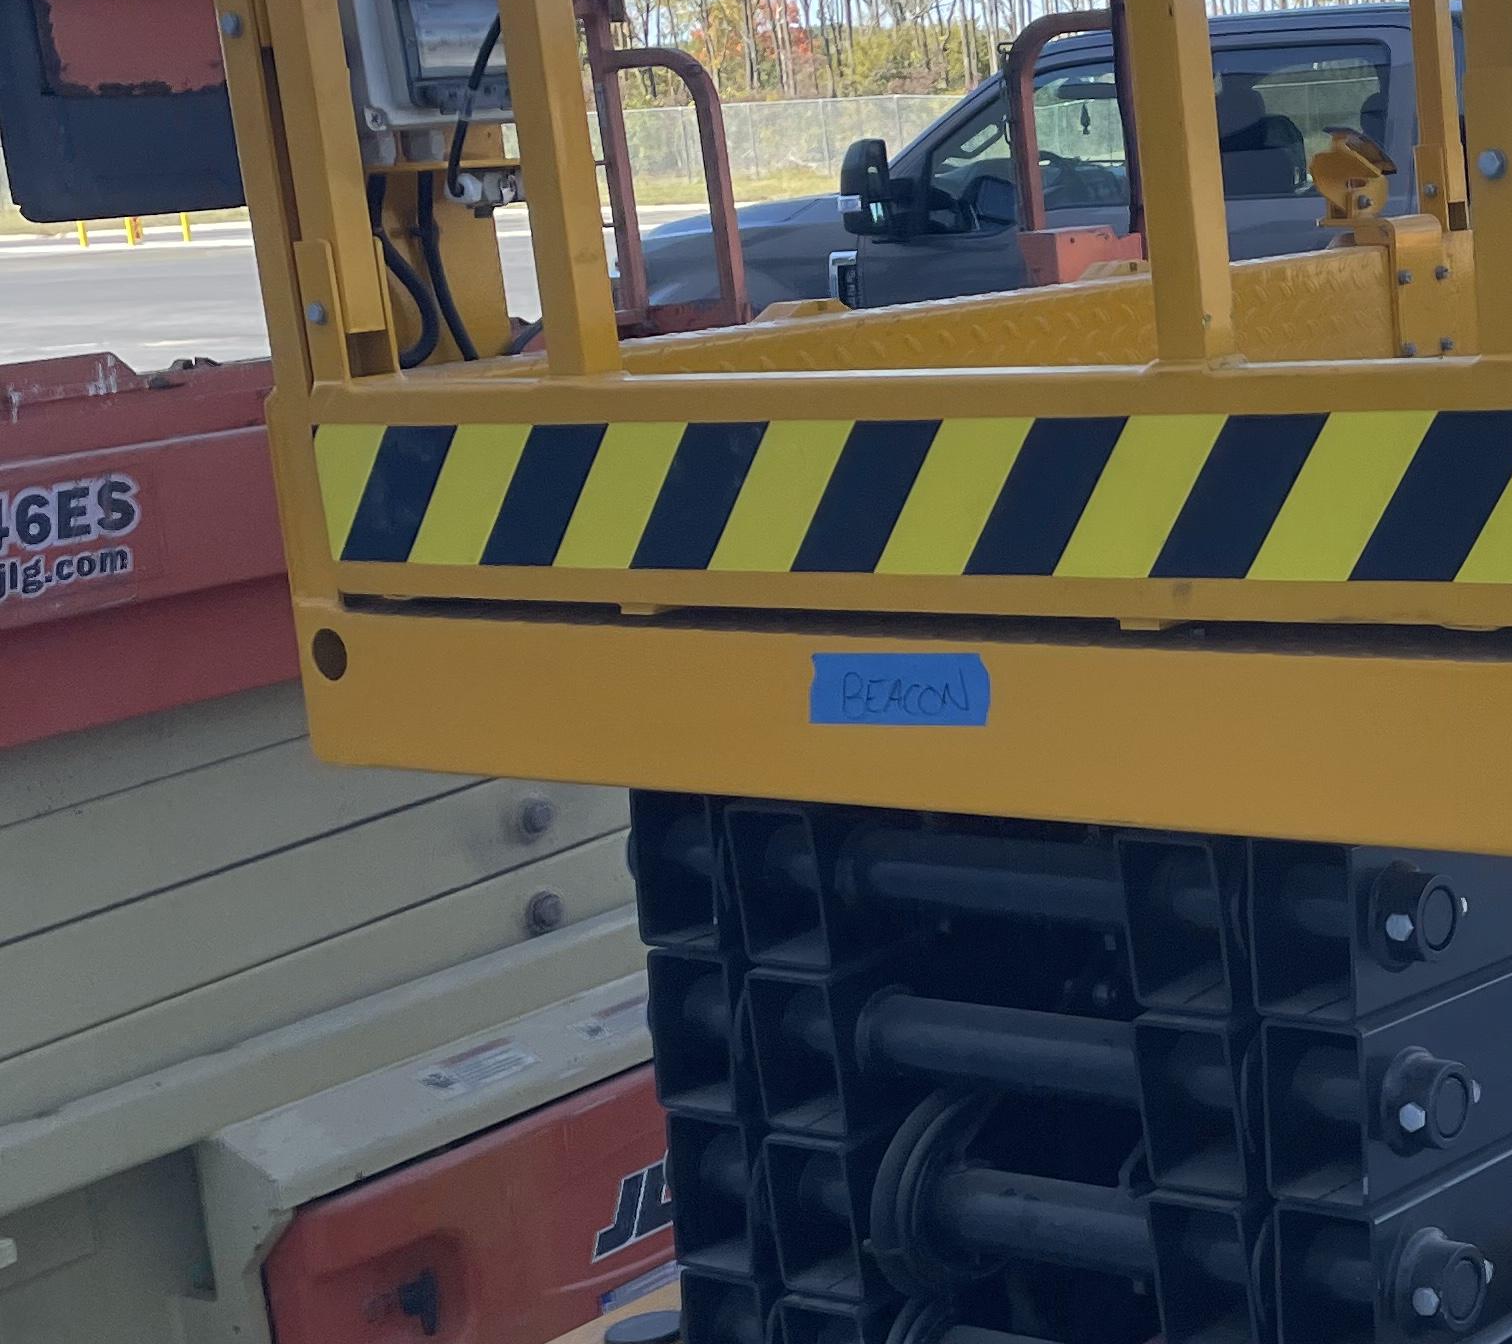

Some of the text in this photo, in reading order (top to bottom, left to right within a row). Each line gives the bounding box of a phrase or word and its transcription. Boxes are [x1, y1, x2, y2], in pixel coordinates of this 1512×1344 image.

[0, 480, 136, 552] 6ES
[842, 666, 971, 721] BEACON
[593, 1158, 674, 1264] JL
